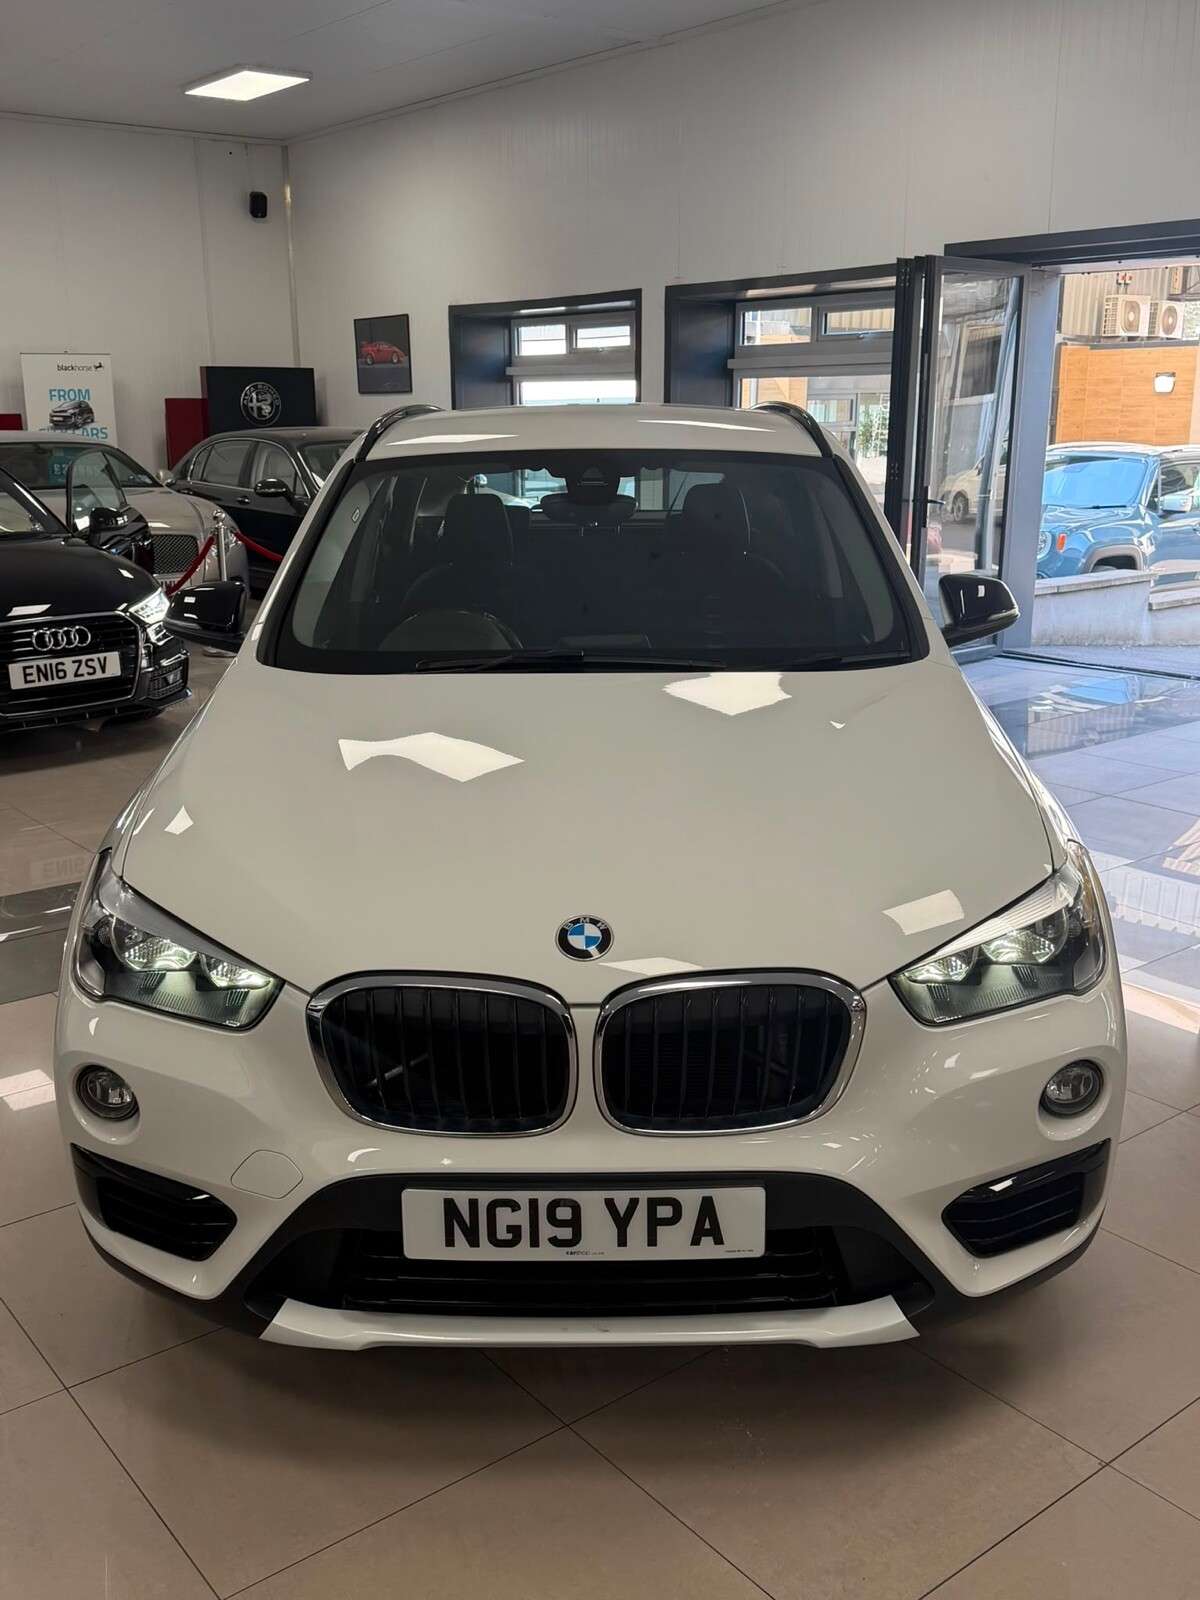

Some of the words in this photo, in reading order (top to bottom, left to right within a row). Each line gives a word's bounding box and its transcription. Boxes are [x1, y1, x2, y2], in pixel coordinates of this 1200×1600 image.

[57, 364, 93, 372] blackhorse
[49, 388, 91, 401] FROM
[77, 427, 108, 440] ARS
[22, 661, 67, 684] EN16
[72, 656, 107, 678] ZSV
[563, 917, 608, 930] BMW
[443, 1197, 582, 1248] NG19
[604, 1195, 725, 1248] YPA
